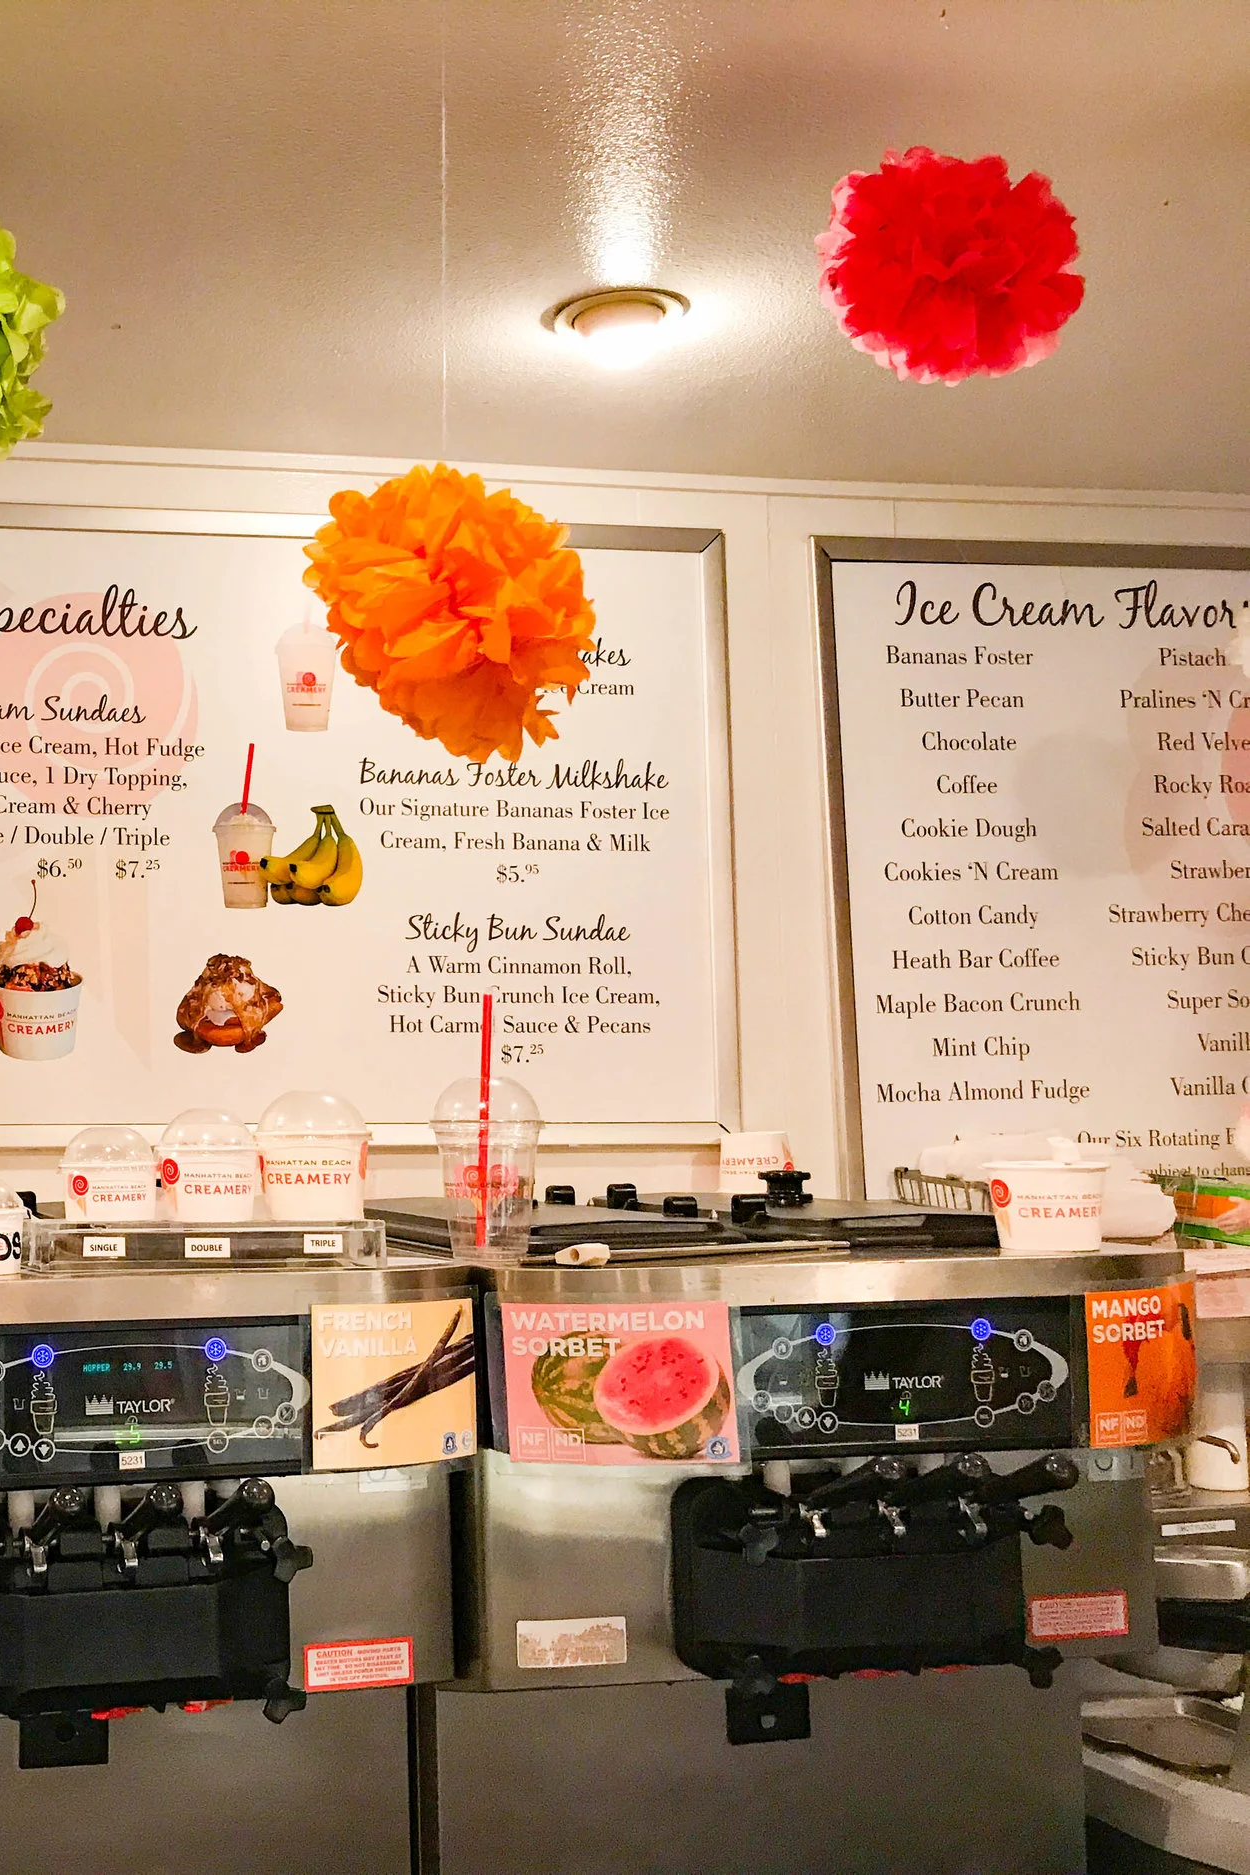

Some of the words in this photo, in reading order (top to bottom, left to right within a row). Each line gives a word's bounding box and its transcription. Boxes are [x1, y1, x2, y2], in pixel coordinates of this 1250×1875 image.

[894, 580, 960, 626] Ice
[971, 581, 1105, 628] Cream
[886, 644, 968, 665] Bananas
[974, 645, 1034, 666] Foster
[40, 693, 147, 724] Sundaes
[900, 688, 961, 708] Butter
[966, 688, 1024, 709] Pecan
[1120, 688, 1196, 709] Pralines
[28, 735, 98, 758] Cream,
[104, 737, 139, 756] Hot
[146, 737, 205, 762] Fudge
[921, 730, 1017, 751] Chocolate
[1157, 731, 1195, 751] Red
[358, 756, 460, 787] Bananas
[466, 761, 542, 789] Foster
[545, 758, 669, 792] Milkshake
[936, 774, 998, 794] Coffee
[1153, 773, 1213, 800] Rocky
[901, 817, 969, 838] Cookie
[975, 817, 1037, 843] Dough
[1141, 816, 1201, 837] Salted
[24, 825, 94, 846] Double
[112, 827, 170, 852] Triple
[884, 861, 962, 882] Cookies
[996, 860, 1059, 881] Cream
[908, 906, 972, 926] Cotton
[978, 904, 1037, 930] Candy
[1108, 902, 1208, 928] Strawberry
[405, 911, 479, 954] Sticky
[486, 913, 538, 941] Bun
[542, 913, 631, 942] Sundae
[406, 956, 421, 974] A
[428, 955, 482, 974] Warm
[487, 955, 581, 975] Cinnamon
[588, 956, 632, 976] Roll,
[5, 1011, 55, 1022] MANHATTAN
[7, 1020, 74, 1035] CREAMERY
[933, 1037, 976, 1057] Mint
[984, 1035, 1030, 1062] Chip
[1115, 1130, 1143, 1148] Six
[1148, 1129, 1229, 1150] Rotating
[265, 1159, 318, 1168] MANHATTAN
[321, 1159, 352, 1167] BEACH
[184, 1183, 252, 1195] CREAMERY
[267, 1172, 351, 1186] CREAMERY
[92, 1193, 146, 1203] CREAMERY
[89, 1243, 118, 1252] SINGLE
[190, 1243, 223, 1252] DOUBLE
[310, 1239, 336, 1248] TRIPLE
[1091, 1296, 1161, 1319] MANGO
[317, 1312, 412, 1333] FRENCH
[510, 1310, 704, 1332] WATERMELON
[1092, 1319, 1164, 1344] SORBET
[318, 1337, 417, 1358] VANILLA
[512, 1337, 621, 1357] SORBET
[83, 1363, 110, 1372] HOPPER
[522, 1432, 545, 1446] NF
[555, 1432, 581, 1446] ND
[897, 1427, 918, 1438] 5231
[122, 1457, 143, 1465] 5231
[316, 1649, 353, 1658] CAUTION
